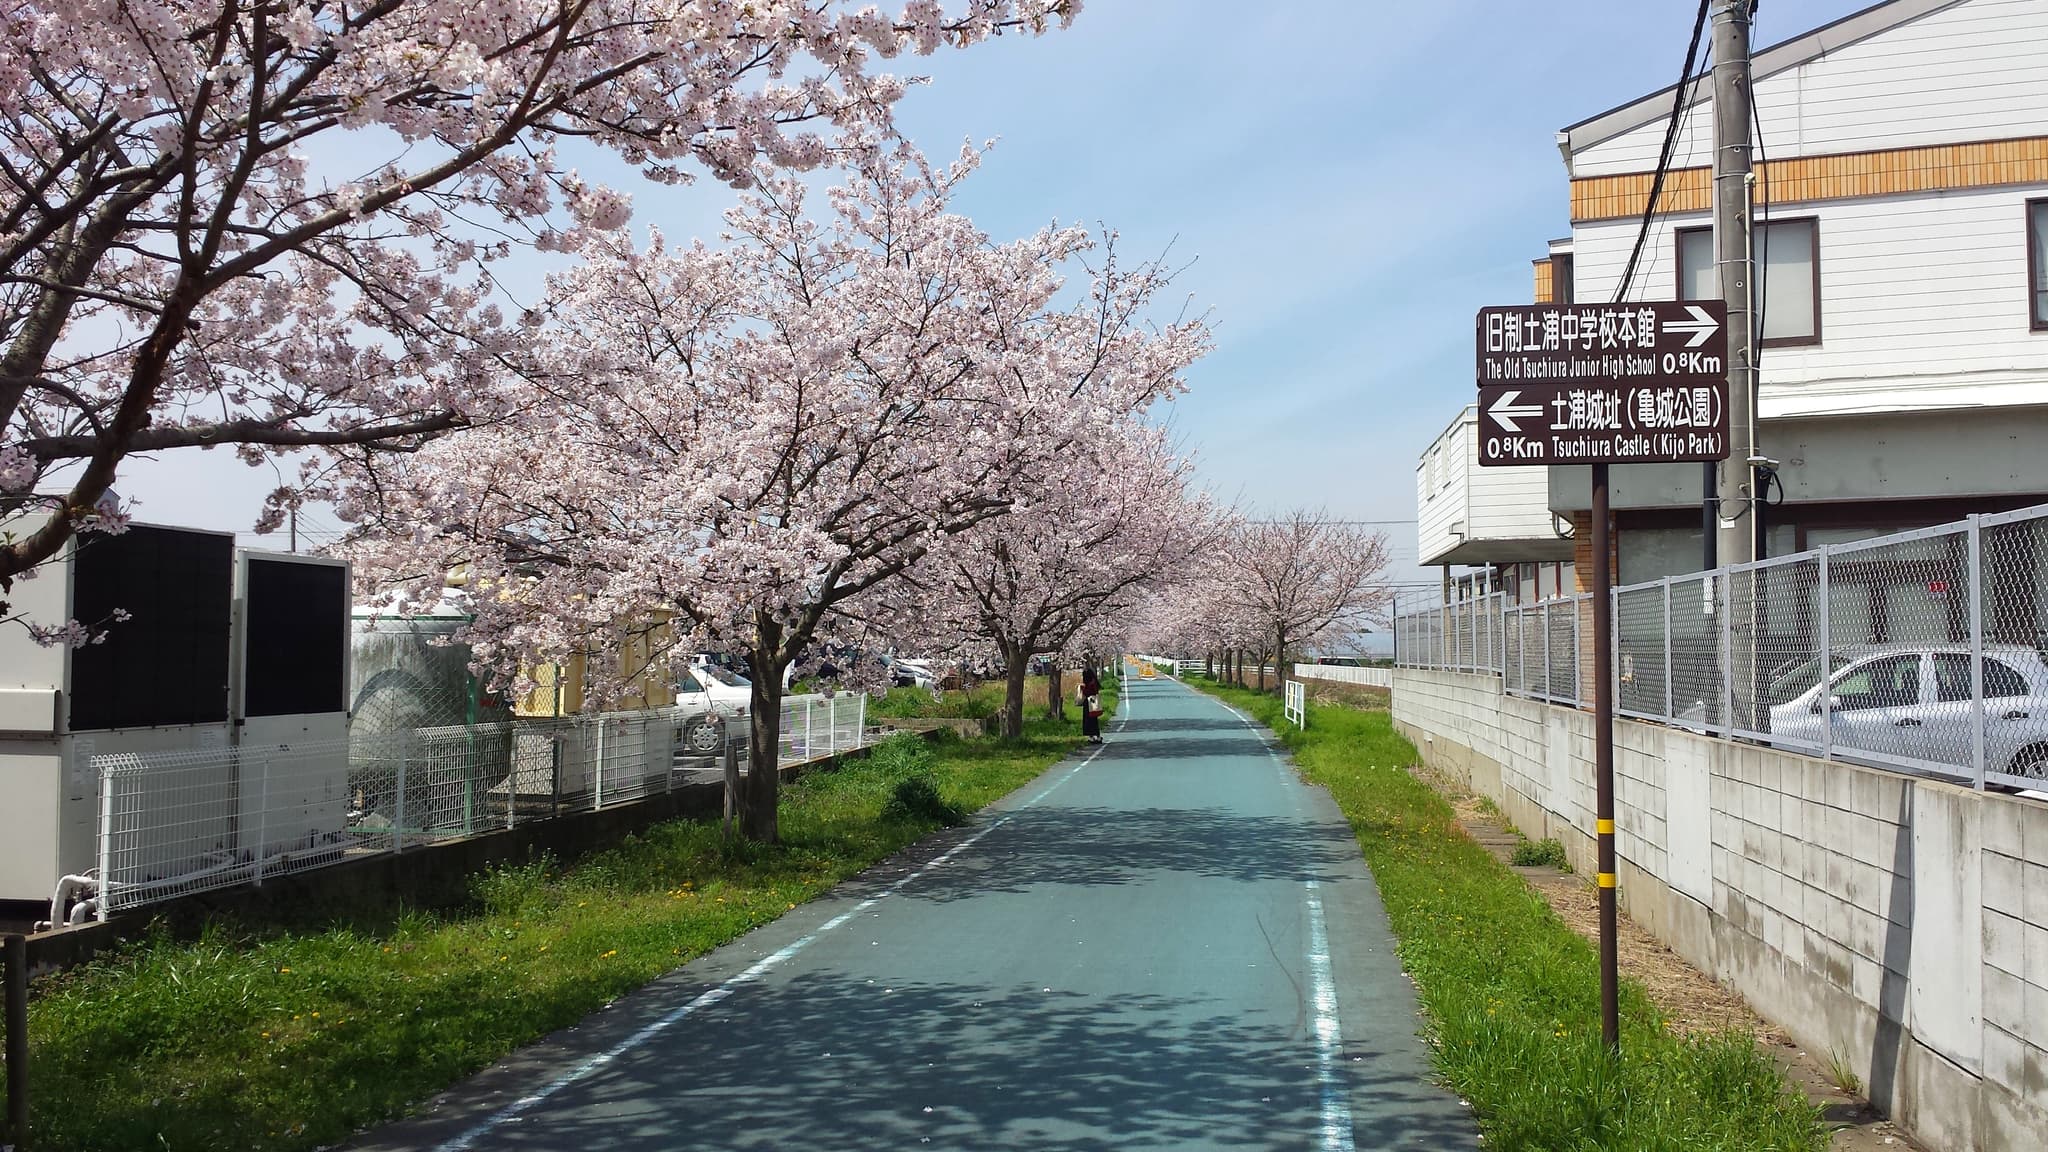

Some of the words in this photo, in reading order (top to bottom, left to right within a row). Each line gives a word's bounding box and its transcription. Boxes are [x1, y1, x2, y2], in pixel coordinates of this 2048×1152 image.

[1485, 307, 1656, 352] 旧制土浦中学校本館
[1485, 358, 1502, 379] The
[1504, 357, 1520, 379] Old
[1522, 356, 1567, 379] Tsuchiura
[1569, 355, 1600, 377] Junior
[1602, 354, 1624, 380] High
[1626, 353, 1656, 376] School
[1552, 434, 1611, 457] Tsuchiura
[1614, 434, 1650, 456] Castle
[1688, 432, 1722, 455] Park)
